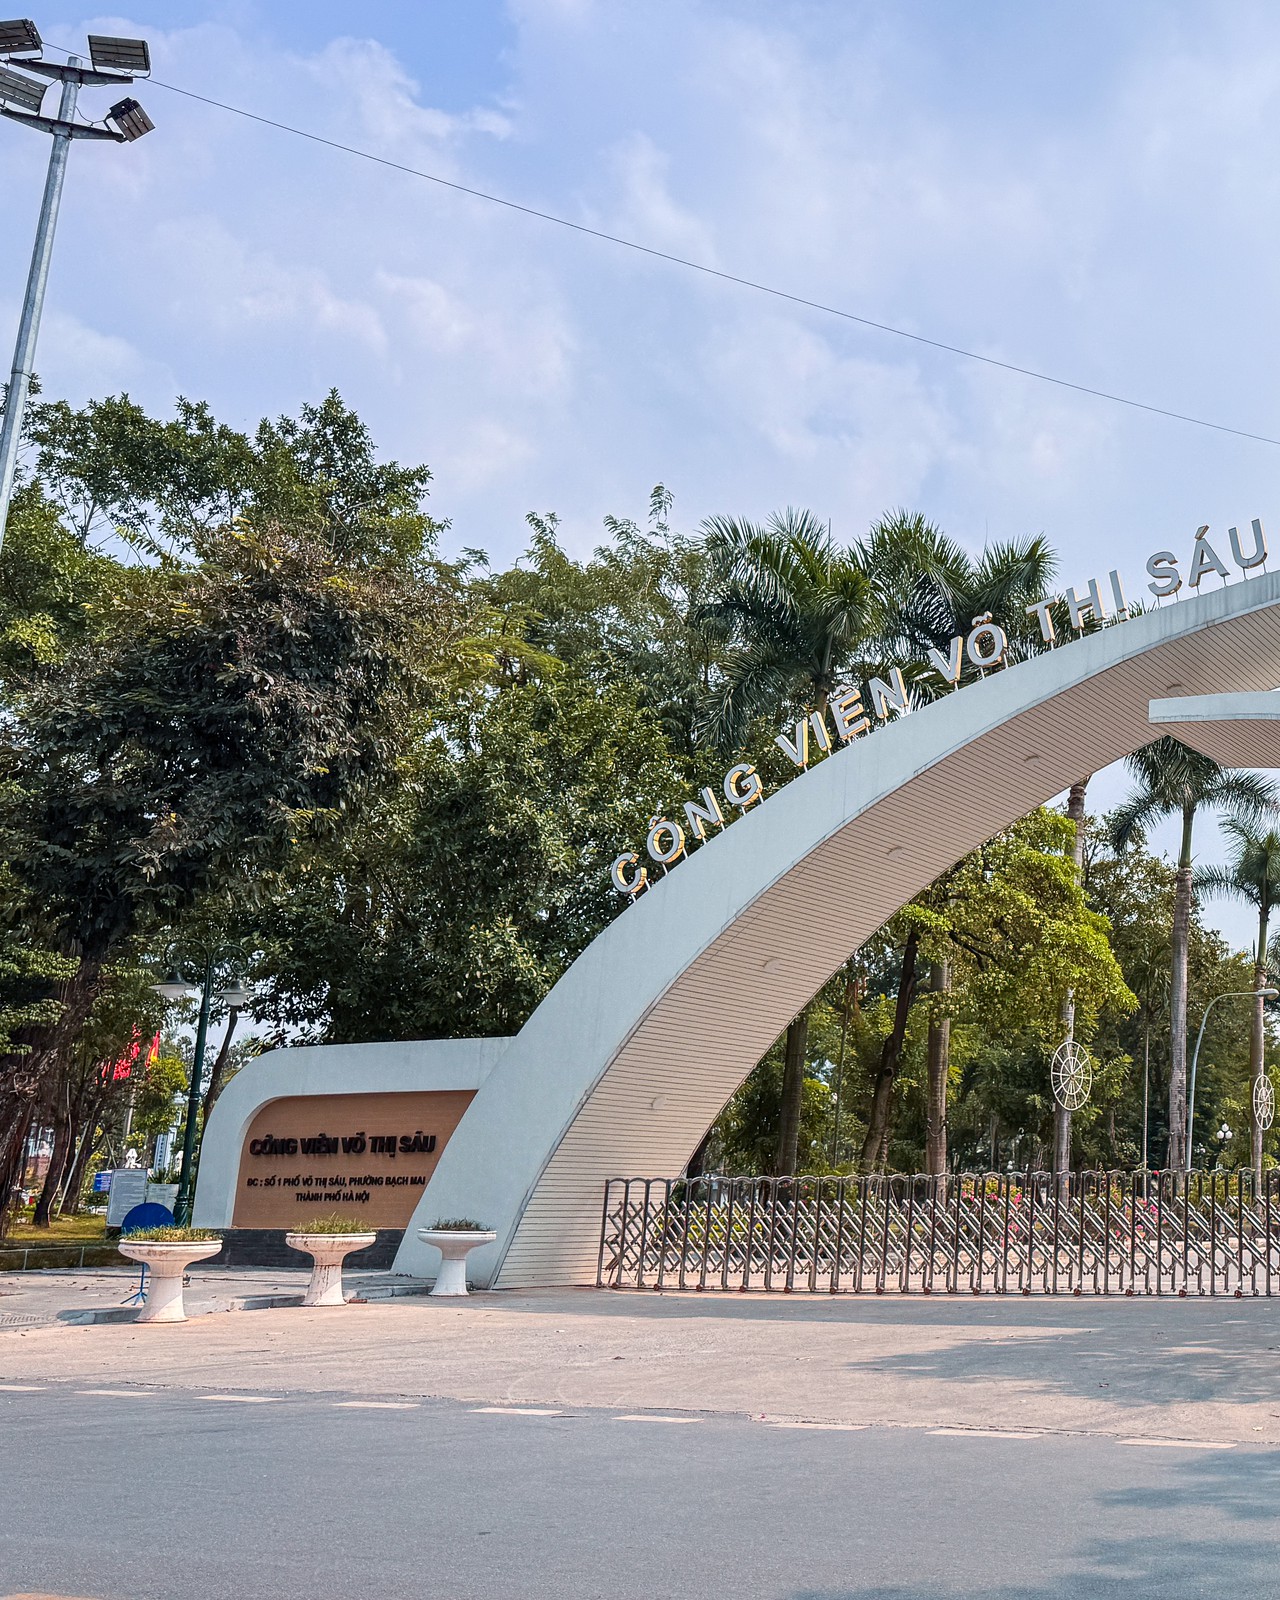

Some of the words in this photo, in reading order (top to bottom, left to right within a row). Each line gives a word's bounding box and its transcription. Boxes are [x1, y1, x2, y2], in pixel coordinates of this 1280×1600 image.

[611, 763, 763, 895] CÔNG
[774, 667, 909, 768] VIÊN
[927, 611, 1008, 684] VÕ
[1025, 569, 1130, 643] THỊ
[1145, 518, 1268, 597] SÁU
[249, 1134, 298, 1155] CÔNG
[299, 1133, 339, 1154] VIÊN
[341, 1131, 367, 1153] VÕ
[368, 1135, 397, 1158] THỊ
[398, 1130, 437, 1153] SÁU
[264, 1175, 276, 1187] SỐ
[278, 1178, 282, 1186] 1
[283, 1174, 300, 1187] PHỐ
[302, 1176, 313, 1187] VÕ
[314, 1177, 328, 1189] THỊ
[385, 1176, 409, 1188] BẠCH
[296, 1190, 323, 1202] THÀNH
[324, 1189, 341, 1202] PHỐ
[342, 1190, 355, 1201] HÀ
